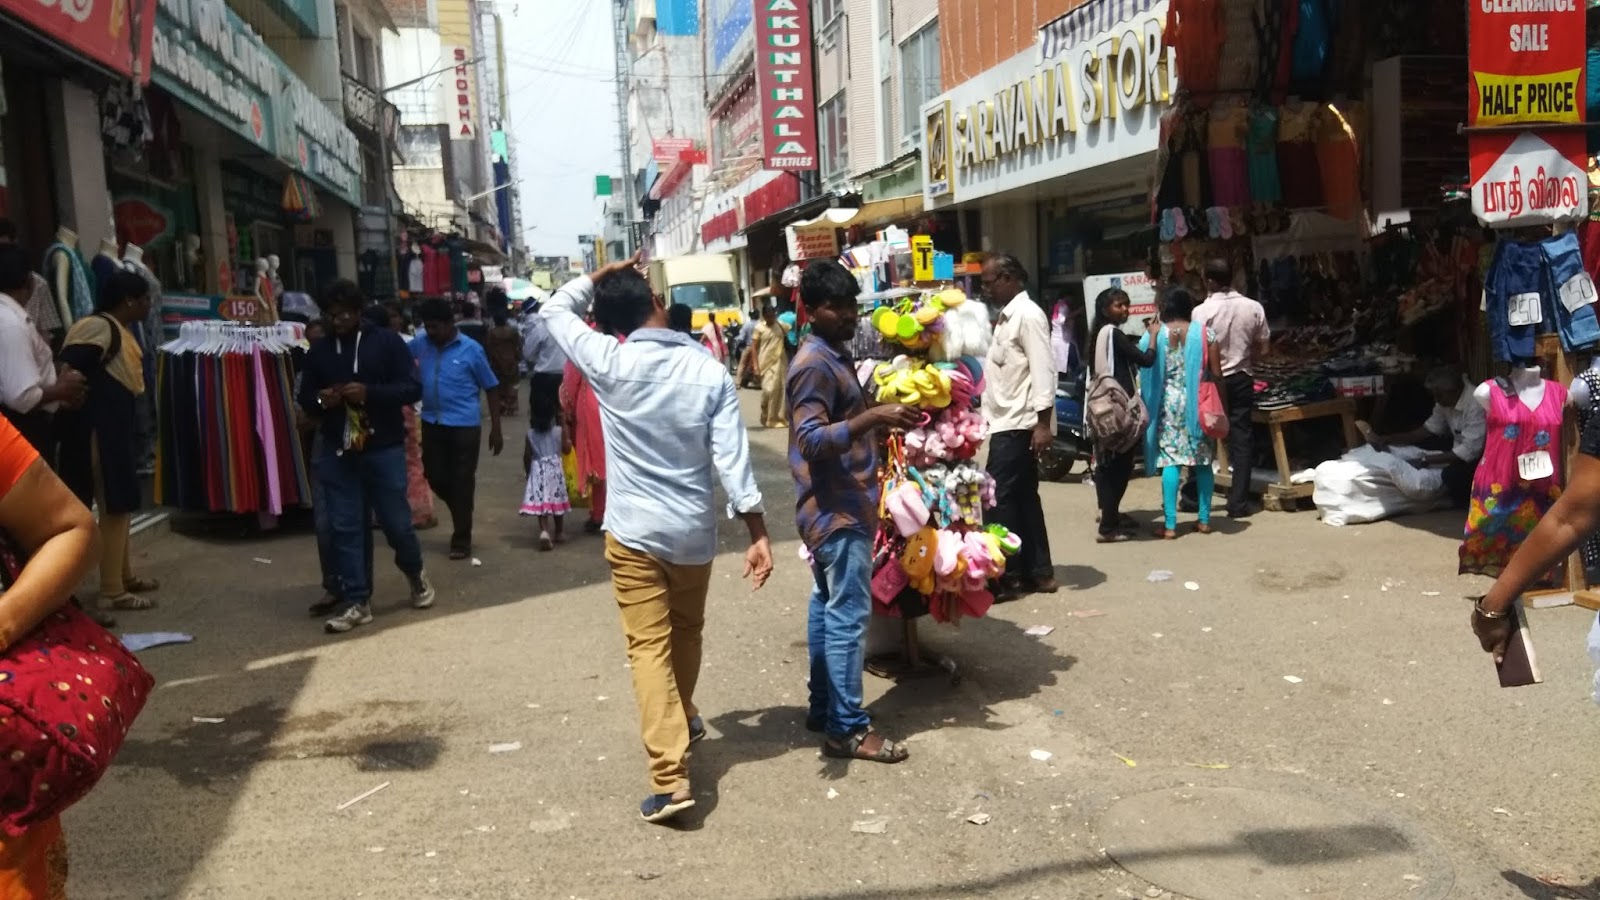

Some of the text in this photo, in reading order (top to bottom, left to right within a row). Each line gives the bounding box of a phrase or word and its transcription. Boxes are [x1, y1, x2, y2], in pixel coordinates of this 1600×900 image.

[1509, 24, 1549, 52] SALE
[454, 48, 471, 136] SHOBHA
[1482, 82, 1574, 116] HALF PRICE
[953, 61, 1076, 169] SARAVANA
[770, 156, 813, 167] TEXTILES
[1482, 165, 1580, 221] பாதி விலை
[1510, 297, 1540, 324] 250
